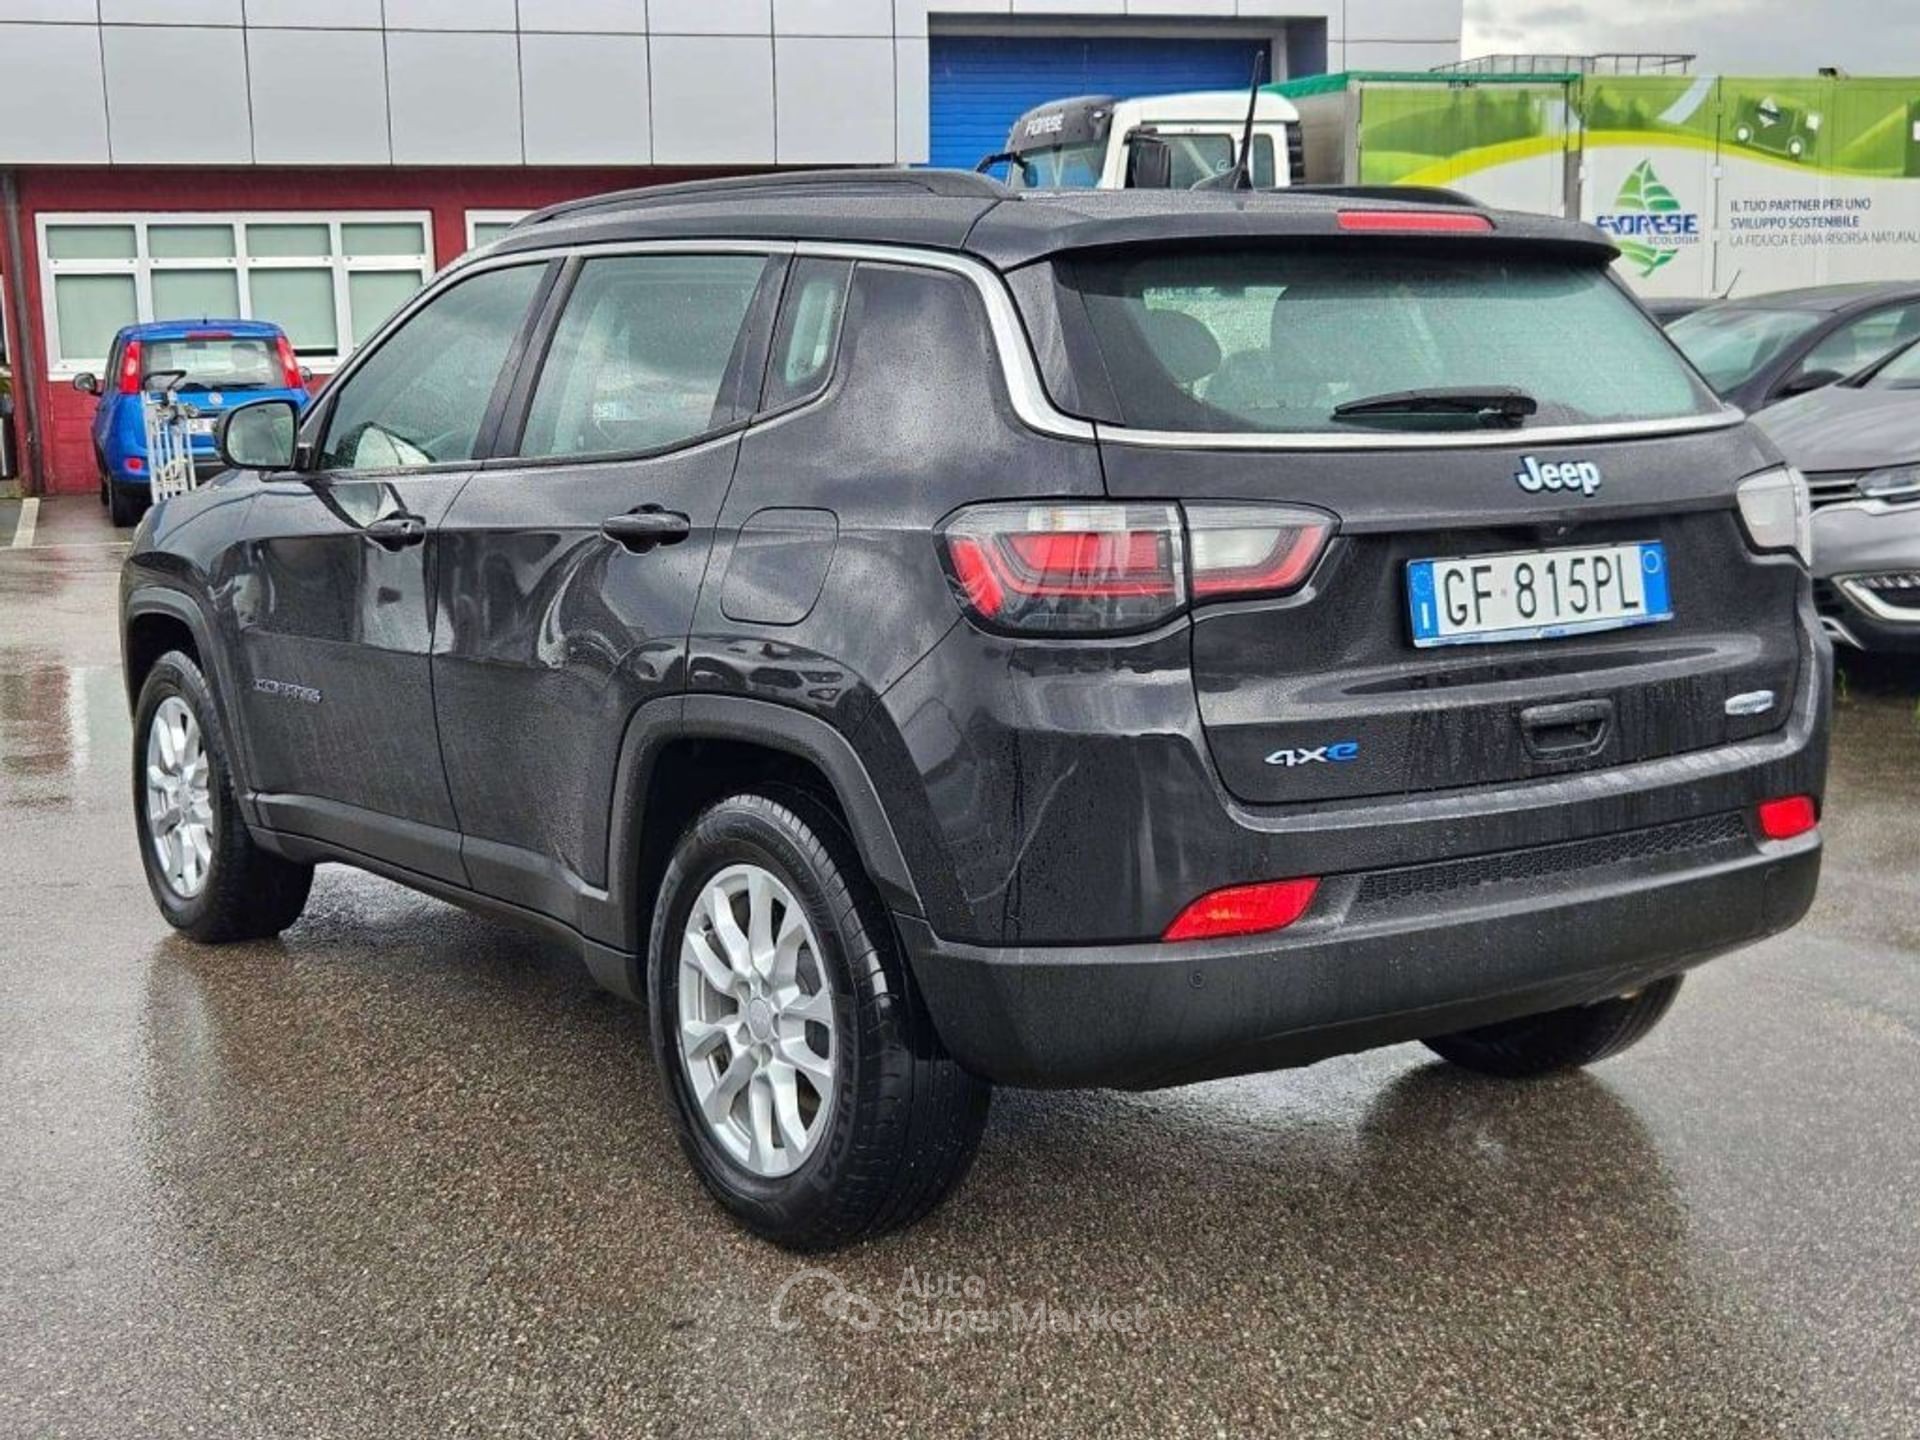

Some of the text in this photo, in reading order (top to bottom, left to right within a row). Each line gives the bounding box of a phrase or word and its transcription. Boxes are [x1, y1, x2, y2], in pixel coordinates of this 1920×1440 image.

[1730, 197, 1871, 212] IL TUO PARTNER PER UNO
[1730, 215, 1859, 229] SVILUPPO SOSTENIBILE
[1516, 456, 1601, 496] Jeep
[1444, 554, 1640, 626] GF 815PL
